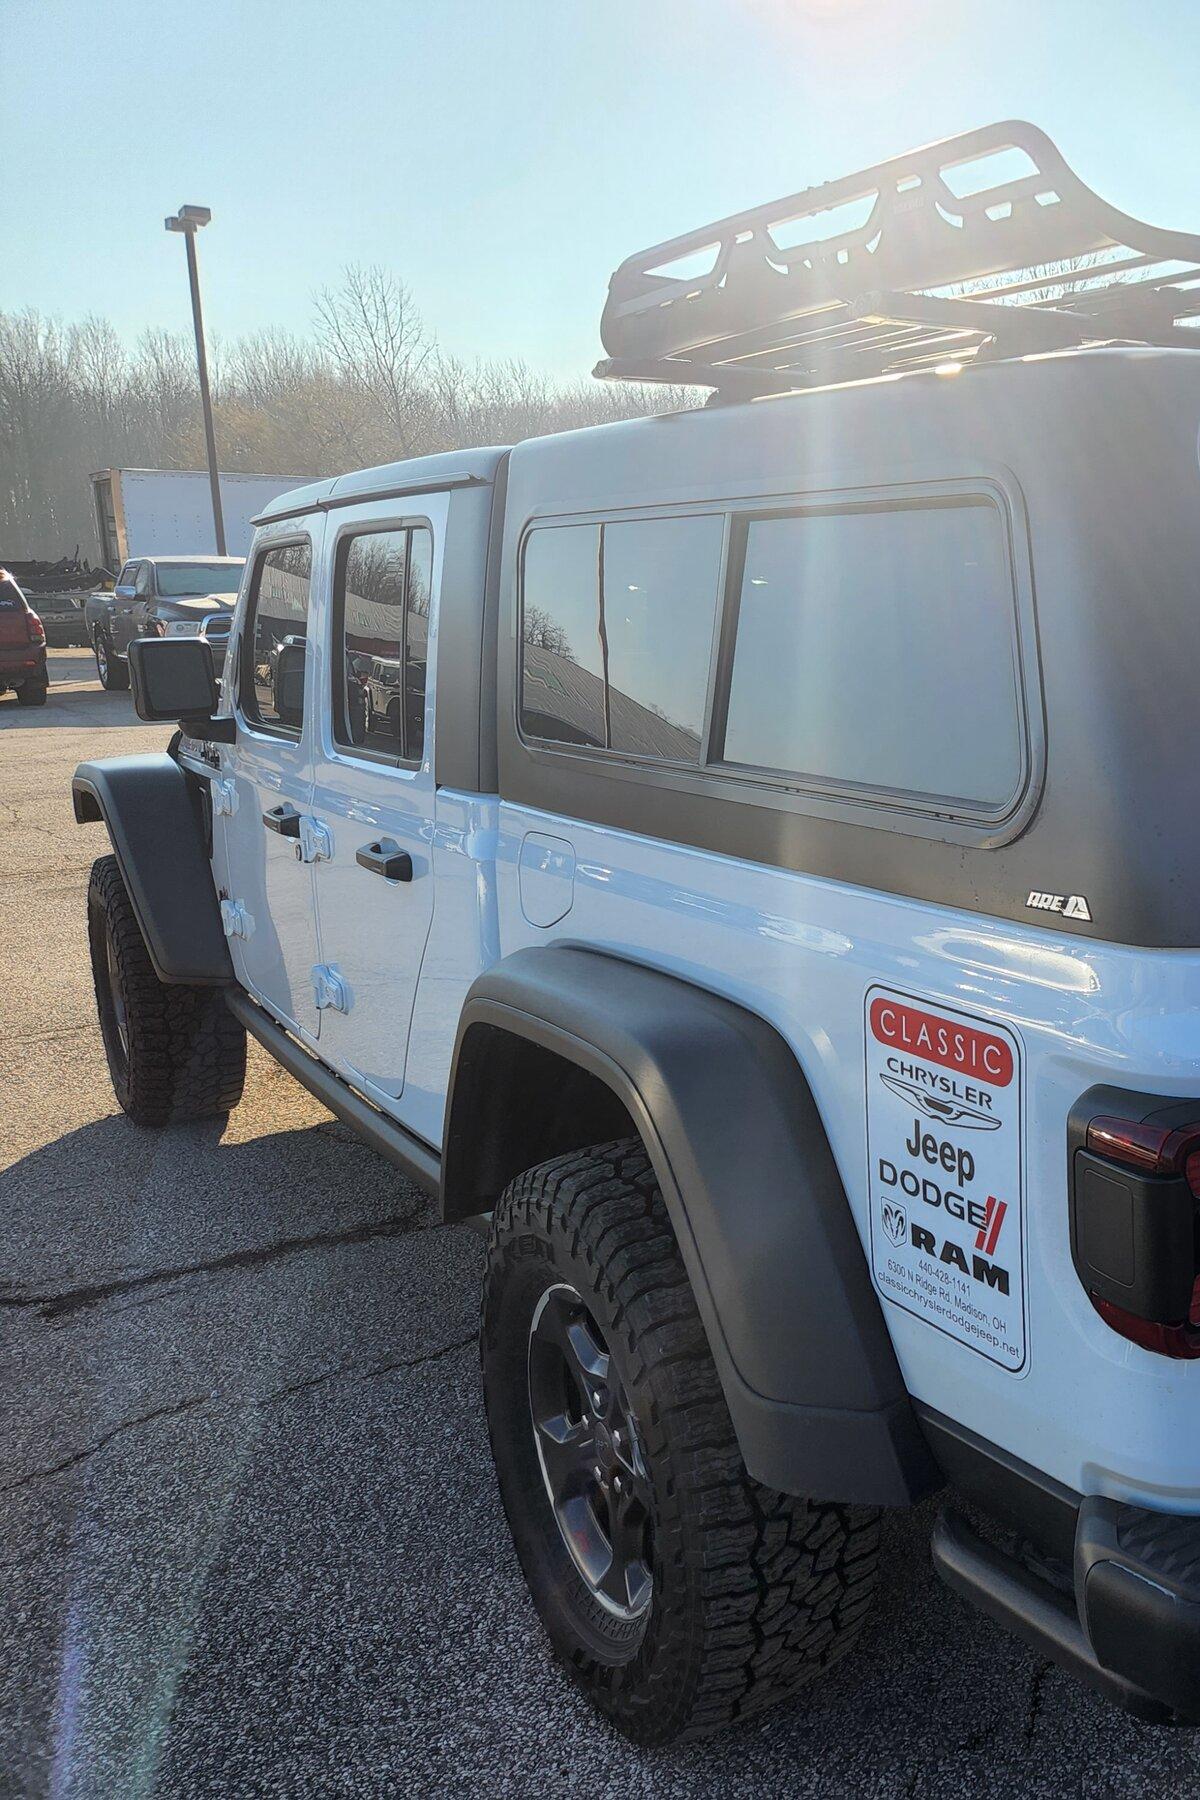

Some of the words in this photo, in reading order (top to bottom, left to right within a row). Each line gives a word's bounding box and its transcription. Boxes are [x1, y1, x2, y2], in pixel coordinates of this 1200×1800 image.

[880, 1009, 1001, 1075] CLASSIC
[886, 1057, 993, 1110] CHRYSLER
[906, 1118, 975, 1187] Jeep
[879, 1158, 988, 1231] DODGE
[911, 1222, 1010, 1296] RAM
[918, 1259, 971, 1296] 440-428-1141
[878, 1271, 1020, 1359] classicchryslerdodgejeep.net
[887, 1258, 906, 1278] 6300
[907, 1269, 914, 1282] N
[915, 1273, 937, 1296] Ridge
[954, 1295, 991, 1327] Madison,
[992, 1316, 1007, 1334] OH
